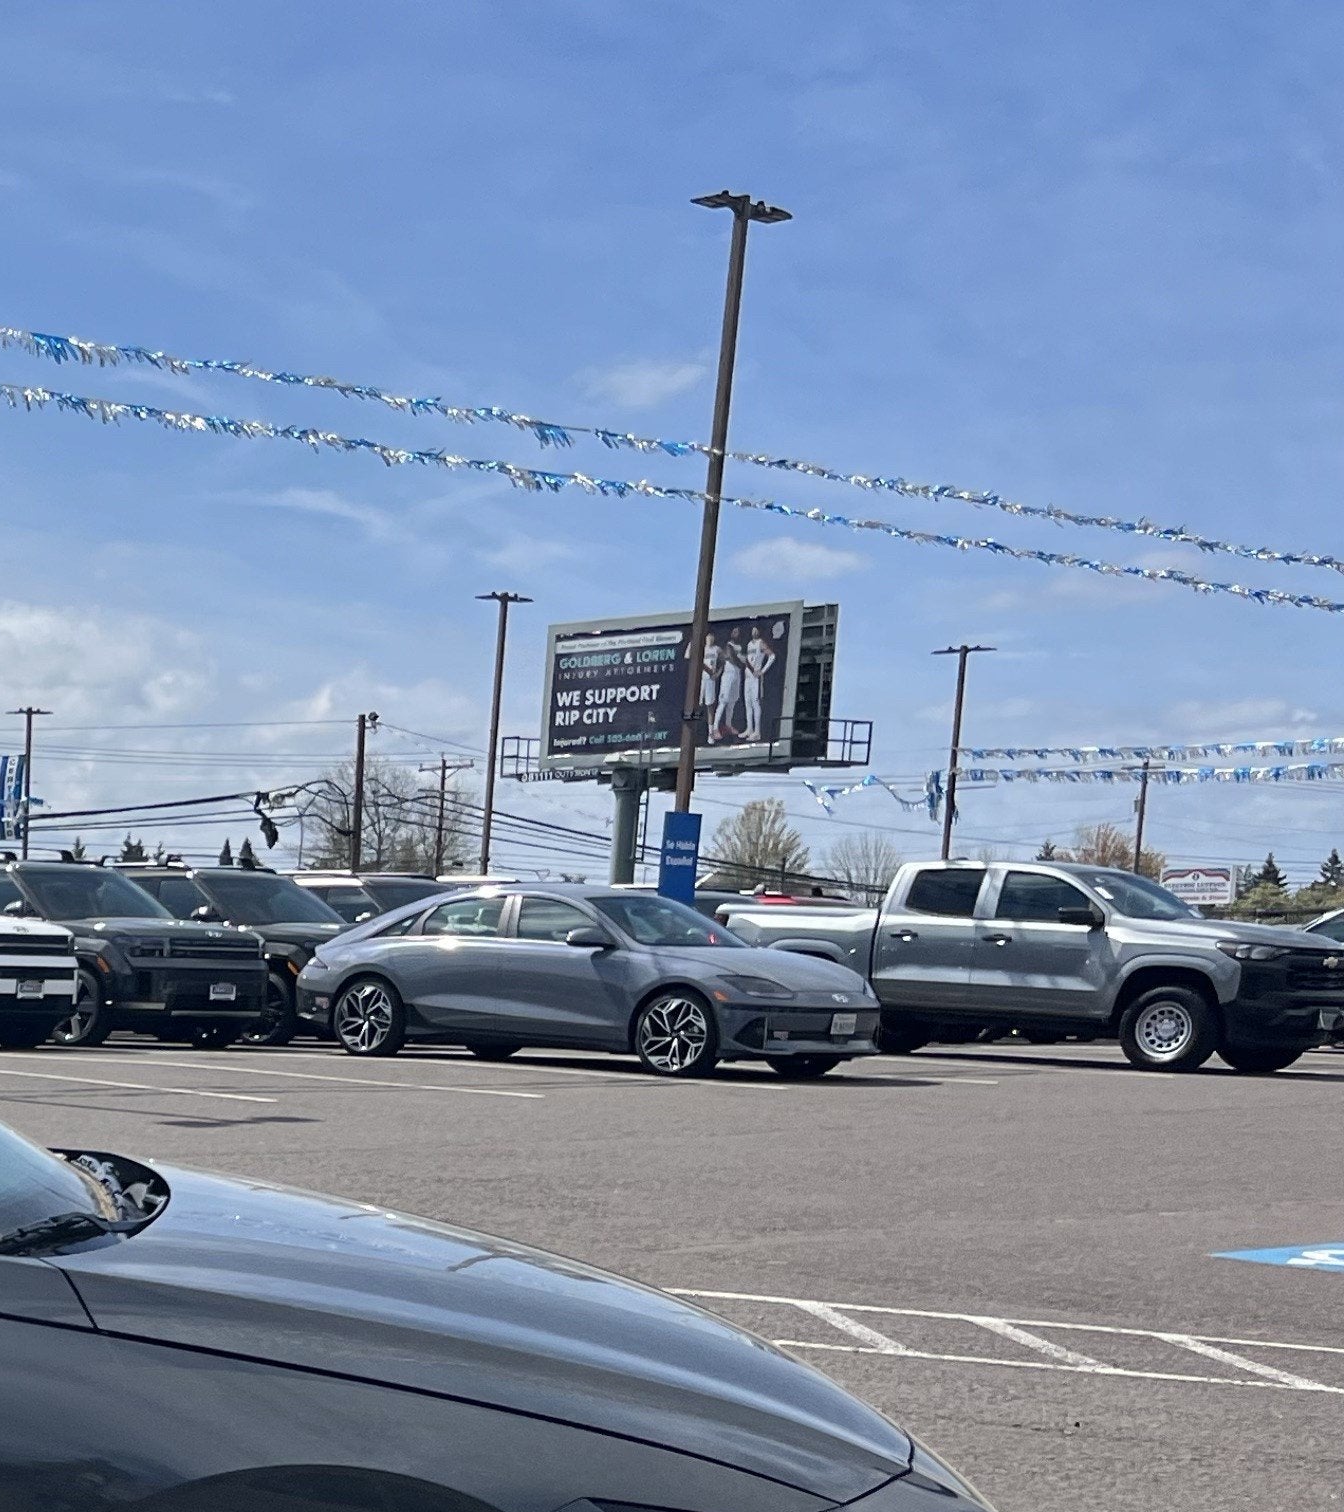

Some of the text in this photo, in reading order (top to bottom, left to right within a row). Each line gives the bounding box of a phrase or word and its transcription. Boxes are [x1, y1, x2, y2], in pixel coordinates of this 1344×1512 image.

[556, 684, 661, 707] WE SUPPORT
[555, 707, 617, 727] RIP CITY
